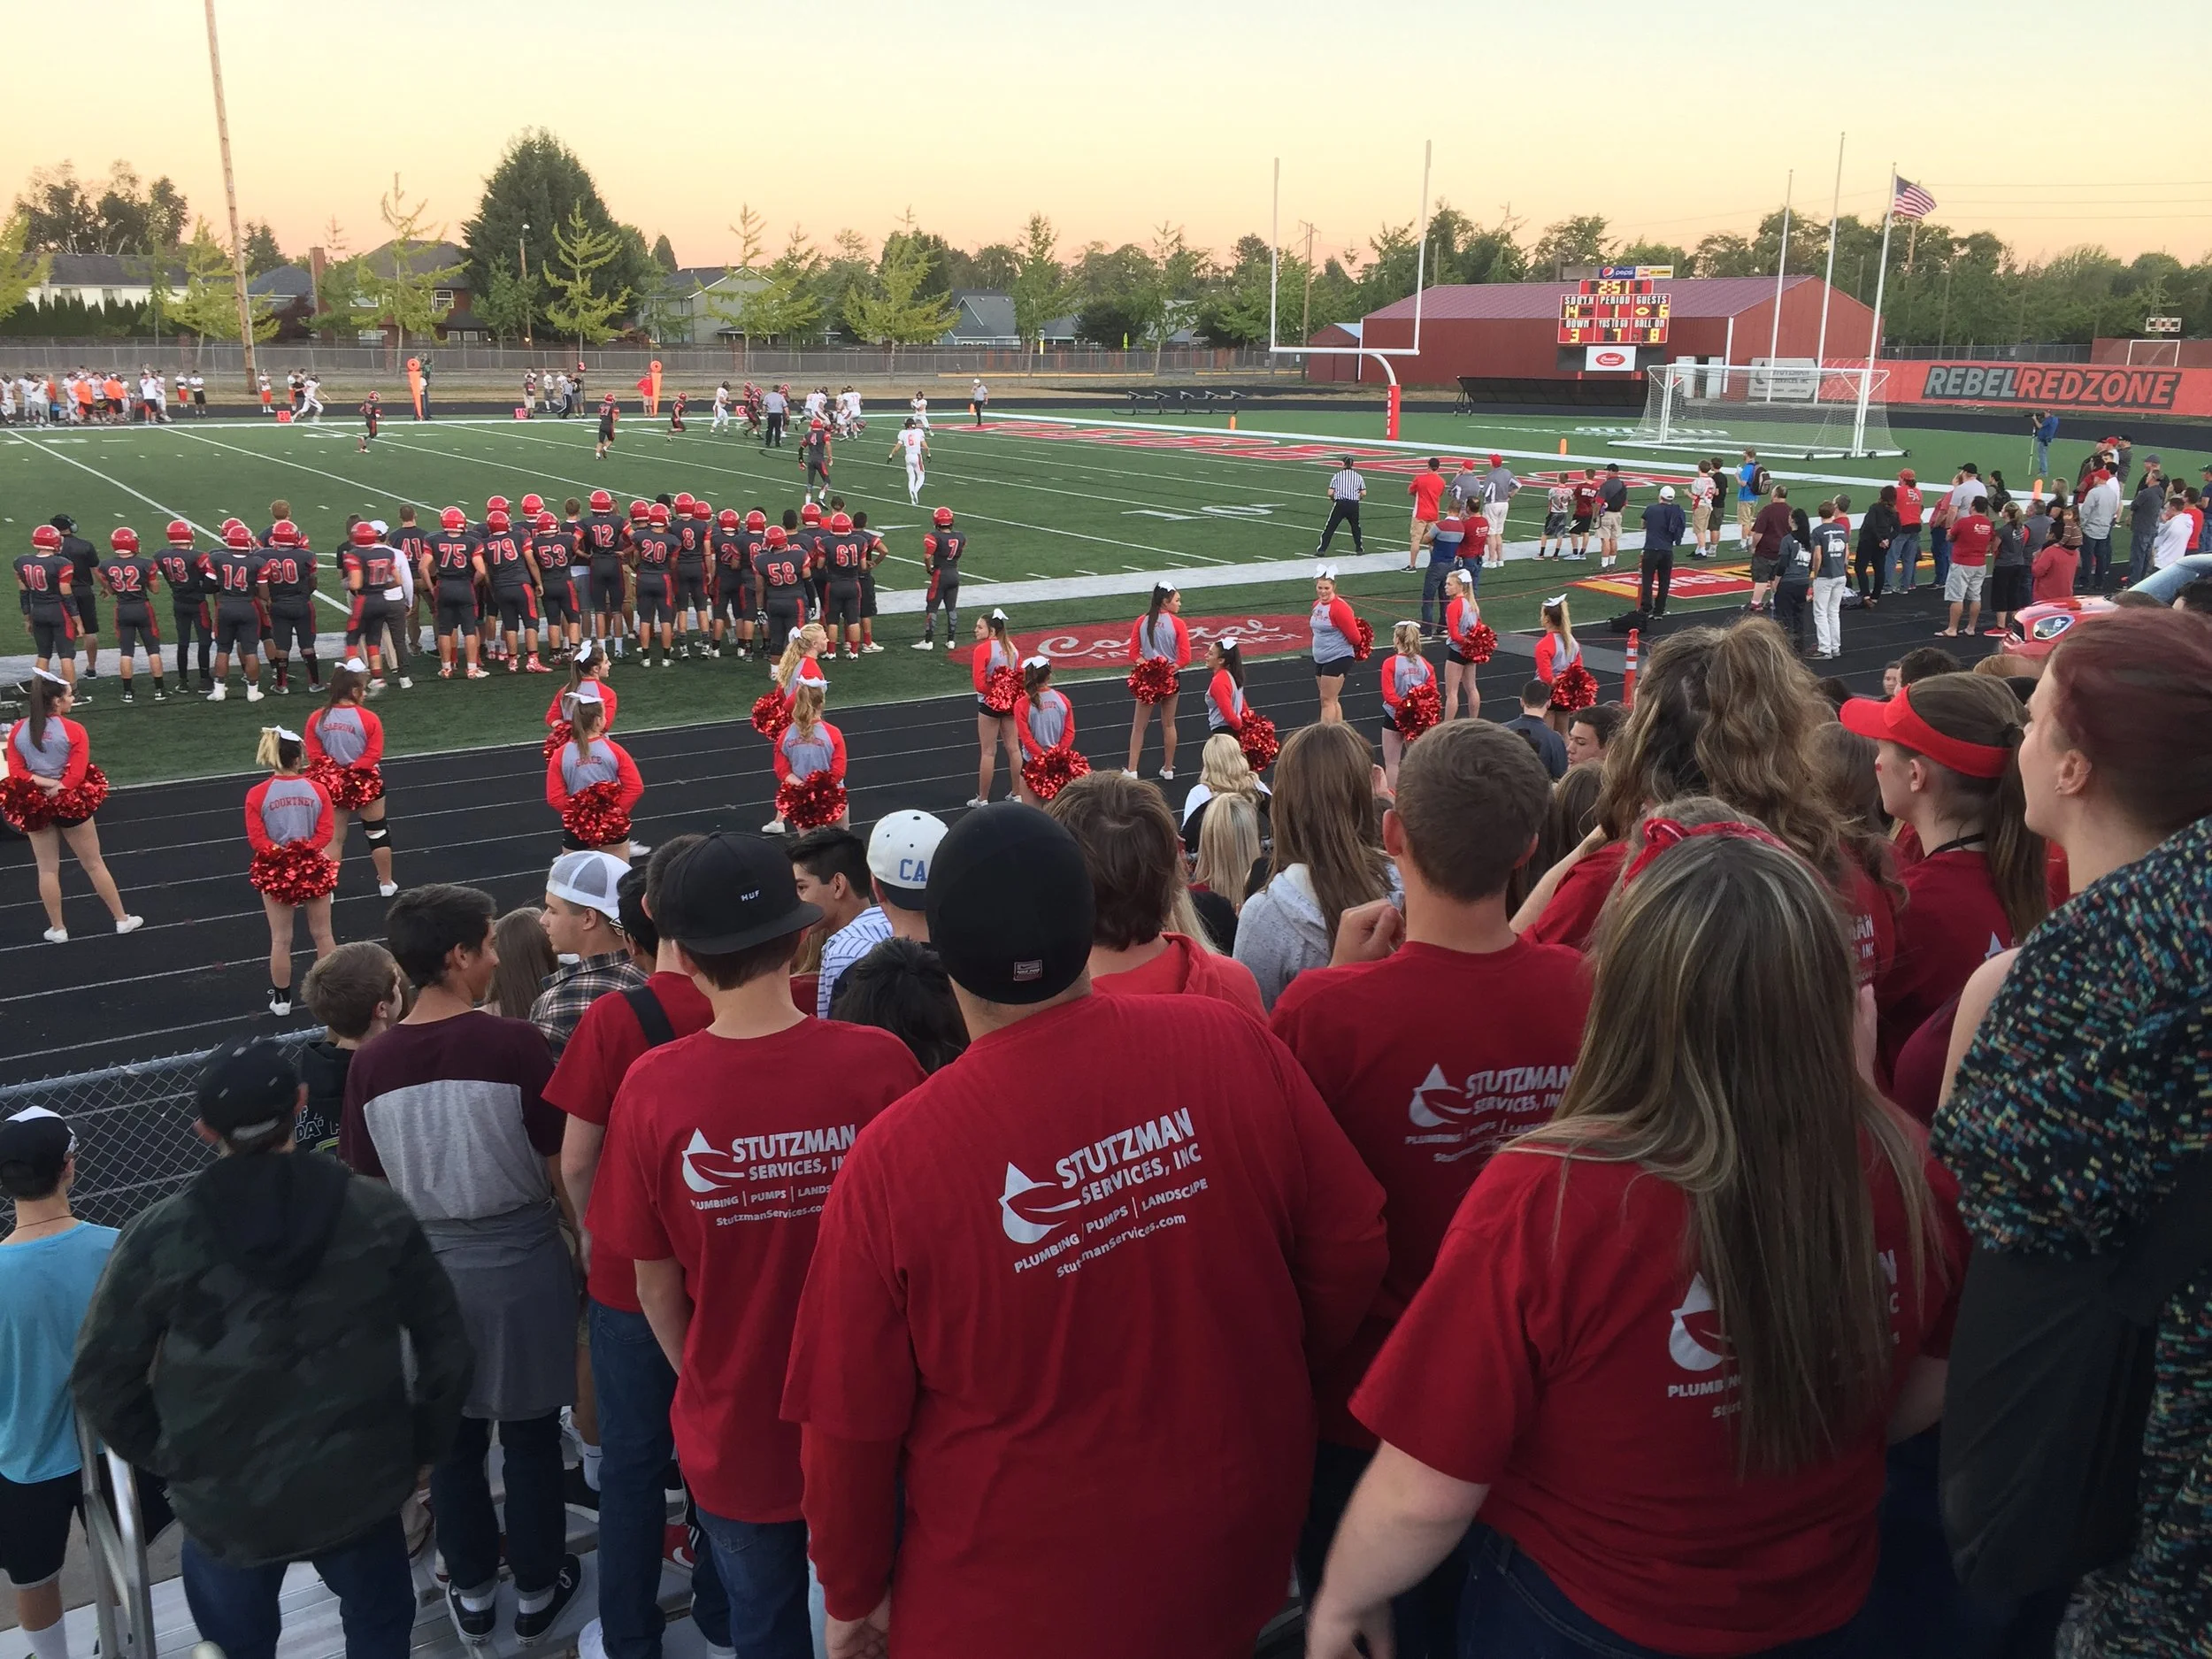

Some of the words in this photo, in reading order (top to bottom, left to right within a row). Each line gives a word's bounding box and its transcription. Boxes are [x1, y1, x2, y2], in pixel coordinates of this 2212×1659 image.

[1598, 280, 1630, 294] 2:51
[1564, 296, 1594, 305] SOUTH
[1564, 304, 1579, 318] 14
[1600, 296, 1631, 305] PERIOD
[1636, 296, 1667, 305] GUESTS
[1658, 304, 1669, 318] 6
[1565, 319, 1590, 328] DOWN
[1570, 328, 1580, 342] 3
[1599, 319, 1610, 328] YDS
[1611, 319, 1619, 328] TO
[1620, 319, 1628, 328] GO
[1612, 328, 1622, 342] 7
[1634, 319, 1652, 328] BALL
[1654, 319, 1664, 328] ON
[1649, 328, 1660, 342] 8
[278, 411, 291, 422] 20
[517, 409, 527, 418] 10
[810, 433, 818, 446] 4
[907, 434, 915, 446] 6
[592, 524, 615, 548] 12
[682, 527, 695, 550] 8
[401, 537, 422, 562] 41
[439, 542, 467, 569] 75
[488, 537, 518, 565] 79
[538, 543, 568, 569] 53
[641, 539, 667, 564] 20
[836, 543, 858, 566] 61
[947, 538, 959, 561] 7
[23, 564, 49, 592] 10
[108, 565, 142, 593] 32
[163, 557, 189, 583] 13
[222, 564, 249, 592] 14
[267, 558, 299, 584] 60
[767, 561, 797, 586] 58
[269, 796, 315, 811] COURTNEY
[741, 890, 760, 902] HUF
[1465, 1065, 1575, 1099] STUTZMAN
[1472, 1094, 1540, 1115] SERVICES,
[732, 1124, 856, 1164] STUTZMAN
[1056, 1107, 1195, 1189] STUTZMAN
[749, 1158, 827, 1181] SERVICES,
[1081, 1157, 1171, 1205] SERVICES,
[1172, 1142, 1202, 1170] INC
[750, 1189, 787, 1202] PUMPS
[716, 1204, 825, 1226] StutzmanServices.co
[1014, 1233, 1080, 1273] PLUMBING
[1086, 1205, 1129, 1233] PUMPS
[1141, 1178, 1209, 1211] LANDSCAPE
[1056, 1213, 1187, 1278] StutmanServices.com
